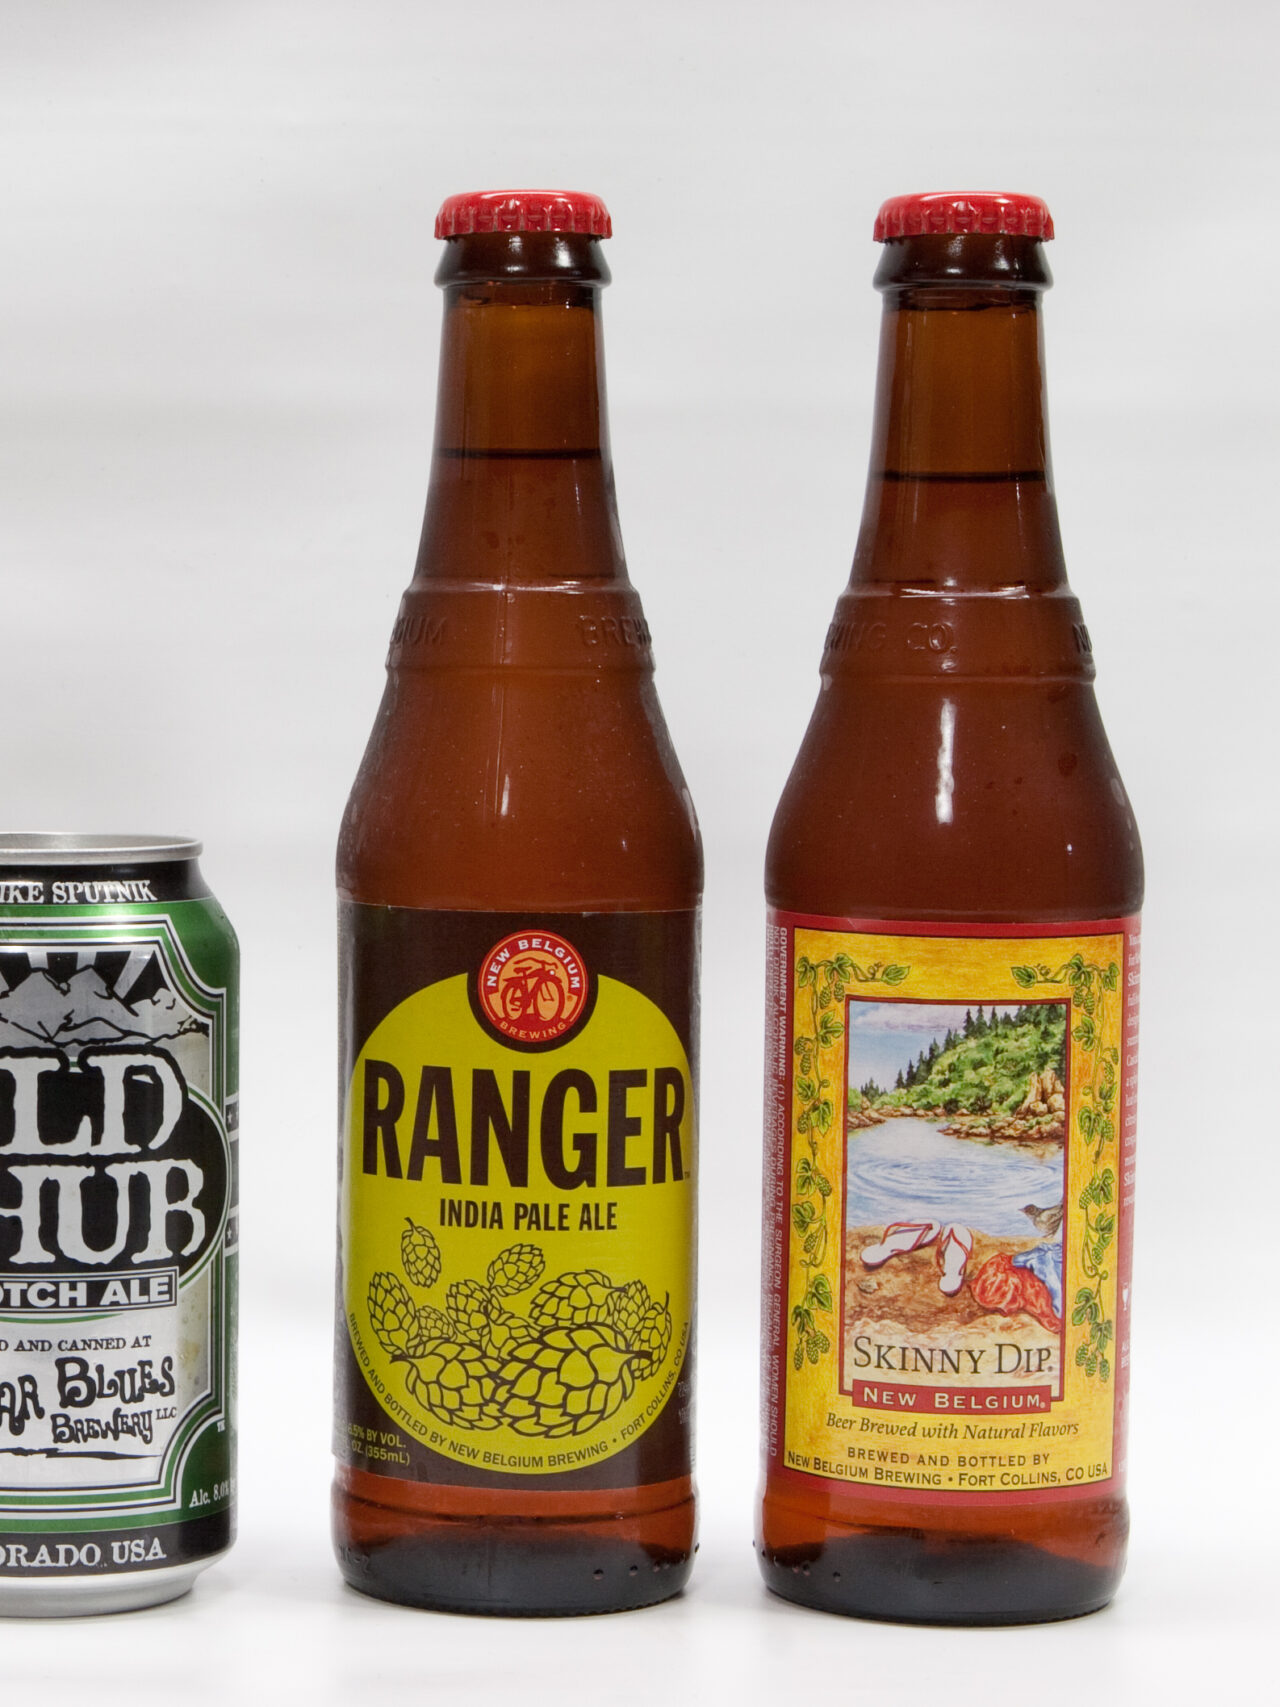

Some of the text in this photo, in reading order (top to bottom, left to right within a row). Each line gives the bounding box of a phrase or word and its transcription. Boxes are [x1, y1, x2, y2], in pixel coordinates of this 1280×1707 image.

[52, 880, 158, 903] SPUTNIK
[487, 938, 580, 989] NEW BELGIUM
[779, 927, 787, 1013] GOVERNMENT
[499, 1021, 567, 1040] BREWING
[362, 1058, 685, 1190] RANGER
[440, 1198, 617, 1231] INDIA PALE ALE
[99, 1276, 171, 1306] ALE
[14, 1338, 52, 1352] AND
[57, 1336, 127, 1351] CANNED
[131, 1334, 152, 1348] AT
[853, 1335, 989, 1374] SKINNY
[350, 1313, 370, 1367] BREWED
[368, 1369, 385, 1394] AND
[383, 1393, 428, 1440] BOTTLED
[429, 1432, 448, 1452] BY
[449, 1439, 480, 1461] NEW
[482, 1452, 544, 1468] BELGIUM
[548, 1441, 608, 1467] BREWING
[620, 1418, 646, 1441] FORT
[645, 1370, 677, 1421] COLLINS,
[674, 1350, 682, 1367] CO
[863, 1386, 916, 1407] NEW
[155, 1407, 177, 1420] LLC
[366, 1428, 378, 1442] BY
[380, 1432, 406, 1448] VOL.
[826, 1412, 1079, 1441] Beer Brewed with Natural Flavors
[365, 1446, 410, 1466] (355mL)
[787, 1450, 810, 1469] NEW
[813, 1456, 868, 1480] BELGIUM
[874, 1465, 942, 1485] BREWING
[958, 1472, 996, 1486] FORT
[1001, 1469, 1061, 1486] COLLINS,
[1066, 1466, 1084, 1482] CO
[1087, 1462, 1108, 1478] USA
[847, 1447, 1050, 1467] BREWED AND BOTTLED BY
[189, 1488, 210, 1508] Alc.
[111, 1537, 167, 1562] USA
